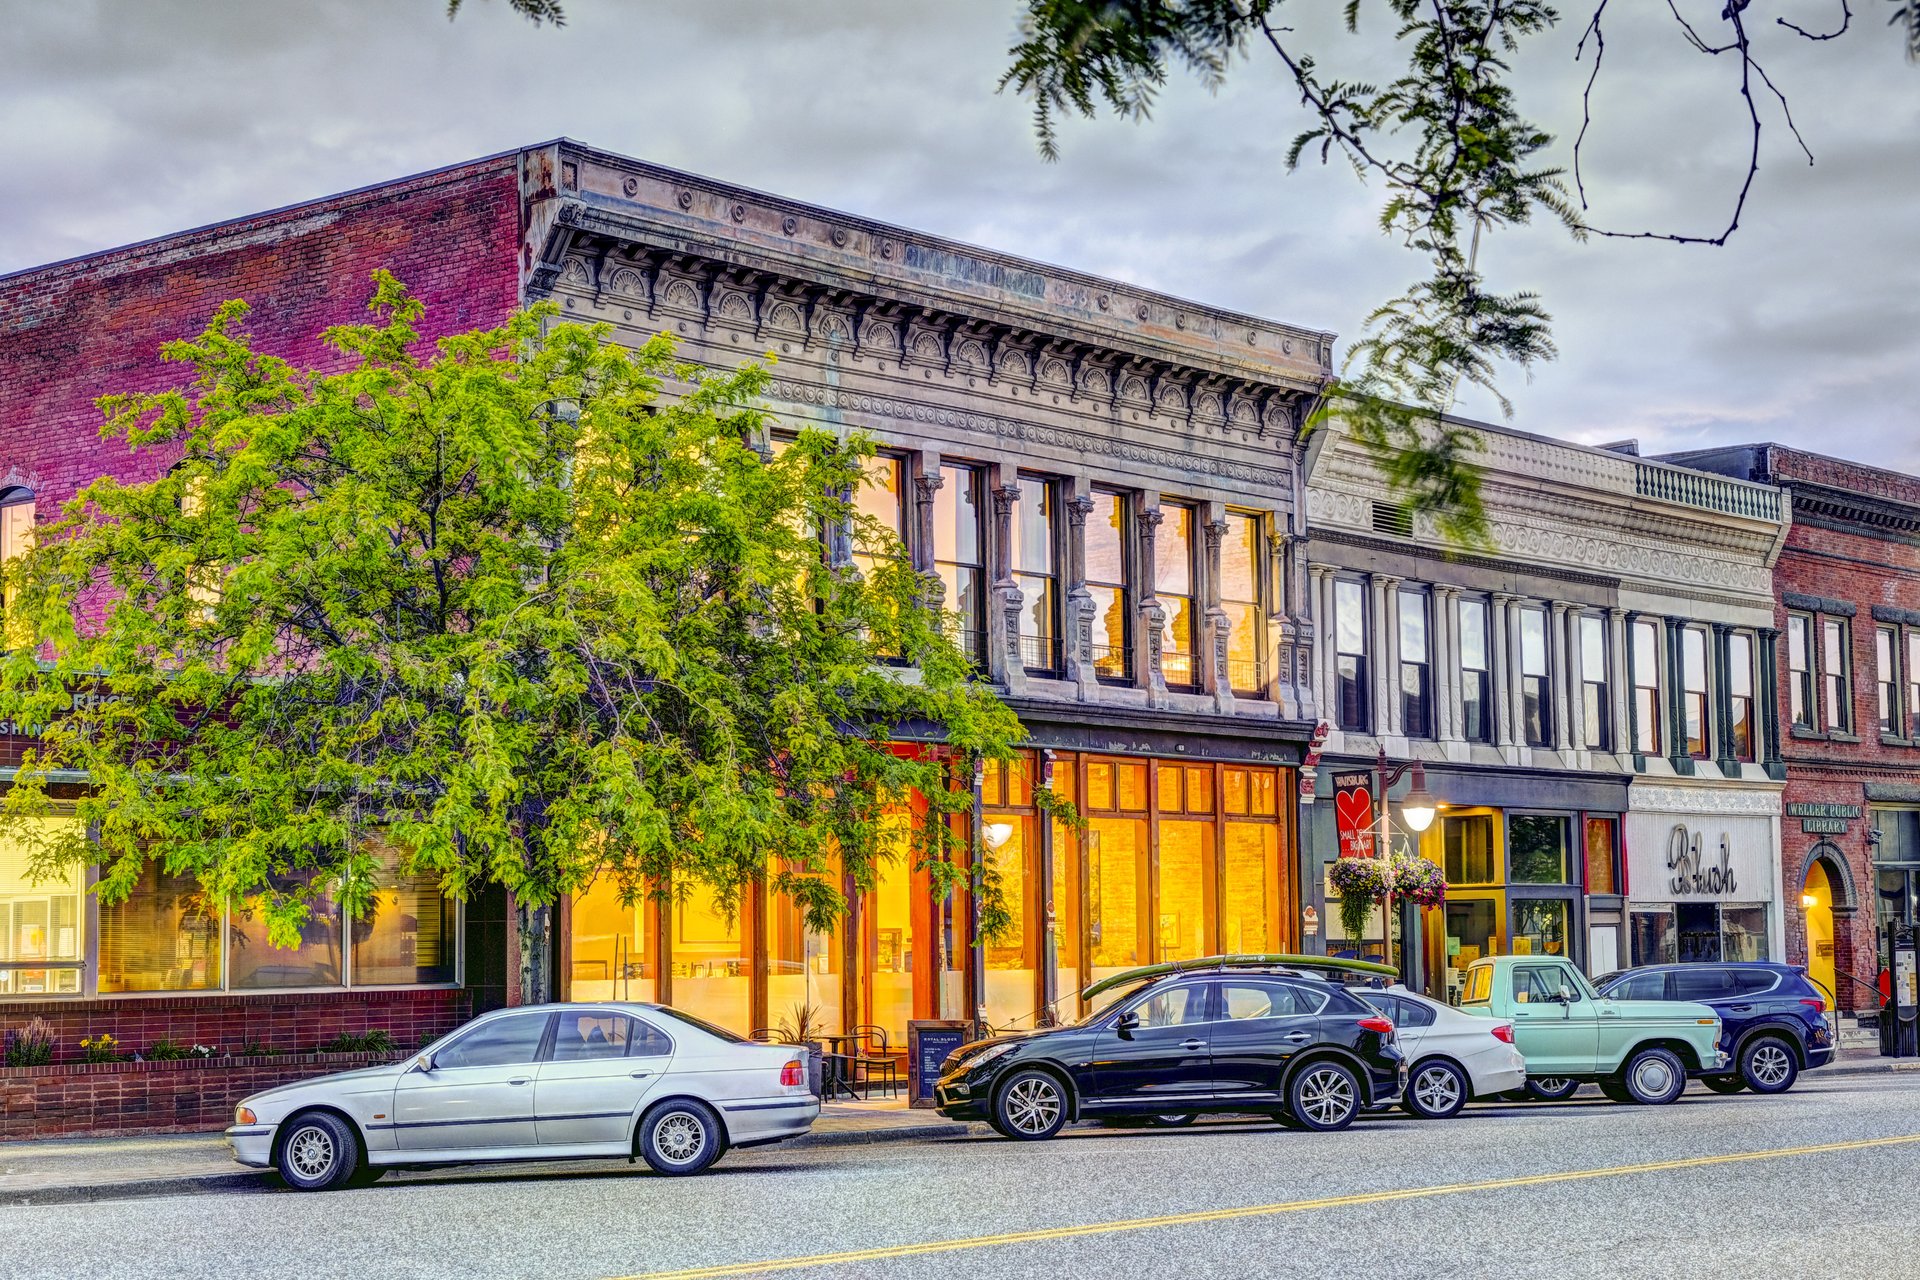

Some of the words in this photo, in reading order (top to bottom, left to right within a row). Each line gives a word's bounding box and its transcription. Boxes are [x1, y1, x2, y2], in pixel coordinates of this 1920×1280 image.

[1335, 775, 1368, 787] WAITSBURG
[1790, 803, 1826, 817] WELLER
[1829, 805, 1861, 818] PUBLIC
[1807, 820, 1846, 833] LIBRARY
[1340, 830, 1355, 840] SMALL
[1667, 823, 1737, 895] Blush
